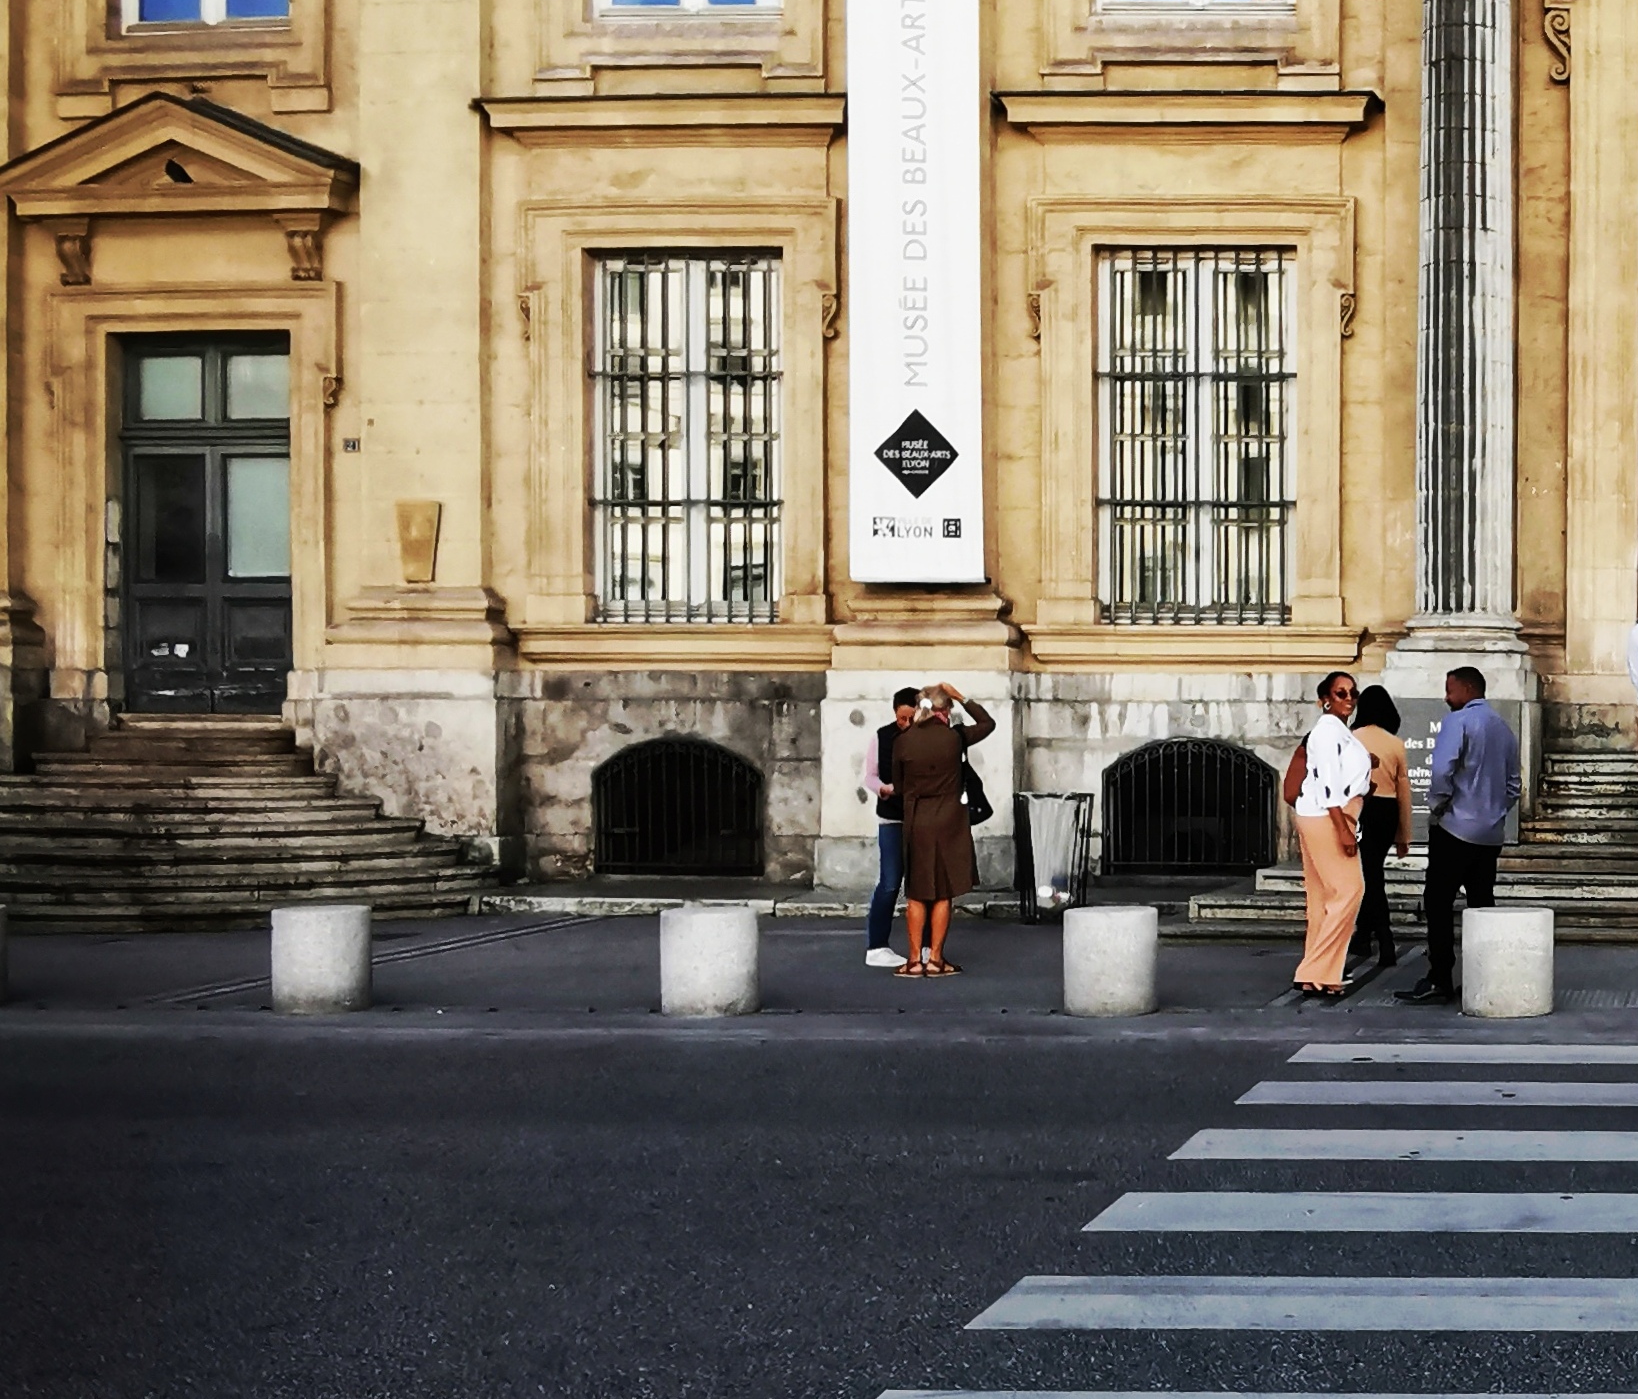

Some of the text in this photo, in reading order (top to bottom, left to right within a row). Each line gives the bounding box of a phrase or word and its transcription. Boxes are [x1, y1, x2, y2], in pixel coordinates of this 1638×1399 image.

[901, 199, 928, 261] DES
[899, 276, 929, 388] MUSÉE
[901, 439, 929, 449] MUSÉE
[883, 450, 900, 459] DES
[897, 526, 933, 538] LYON
[1404, 737, 1424, 749] des
